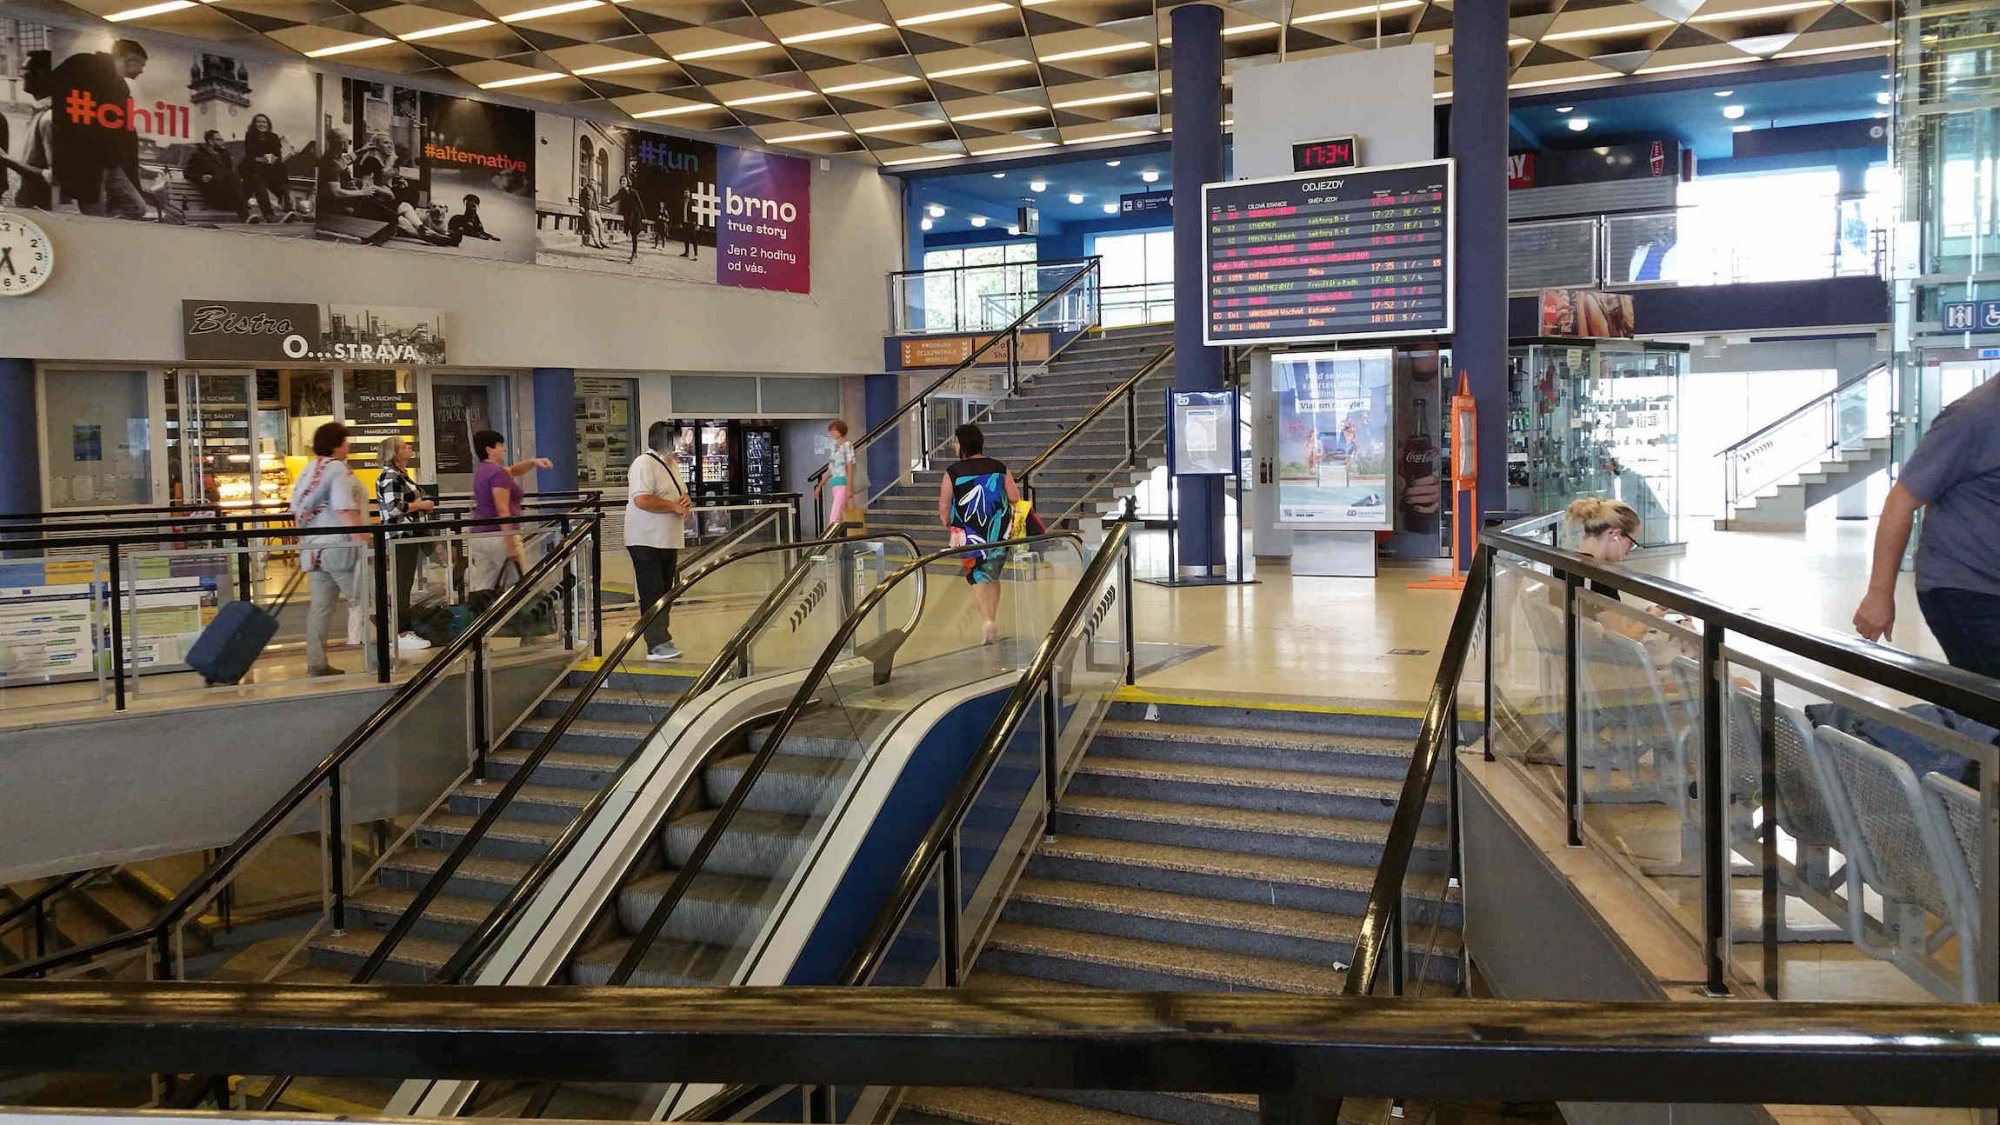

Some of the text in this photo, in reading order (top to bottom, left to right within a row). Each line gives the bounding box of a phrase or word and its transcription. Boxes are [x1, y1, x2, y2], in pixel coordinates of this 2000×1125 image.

[65, 89, 190, 139] #chill
[424, 143, 527, 172] #alternative
[639, 140, 700, 172] #fun
[1304, 143, 1349, 166] 17:34
[1301, 180, 1345, 192] ODJEZDY
[691, 181, 797, 223] #brno
[726, 219, 787, 240] true story
[30, 239, 38, 248] 2
[35, 252, 43, 261] 3
[727, 244, 796, 264] Jen 2 hodiny
[30, 266, 38, 274] 4
[727, 261, 767, 274] od vás.
[4, 278, 11, 287] 6
[20, 275, 28, 284] 5
[1371, 301, 1395, 310] 17:52
[189, 305, 294, 335] Bistro
